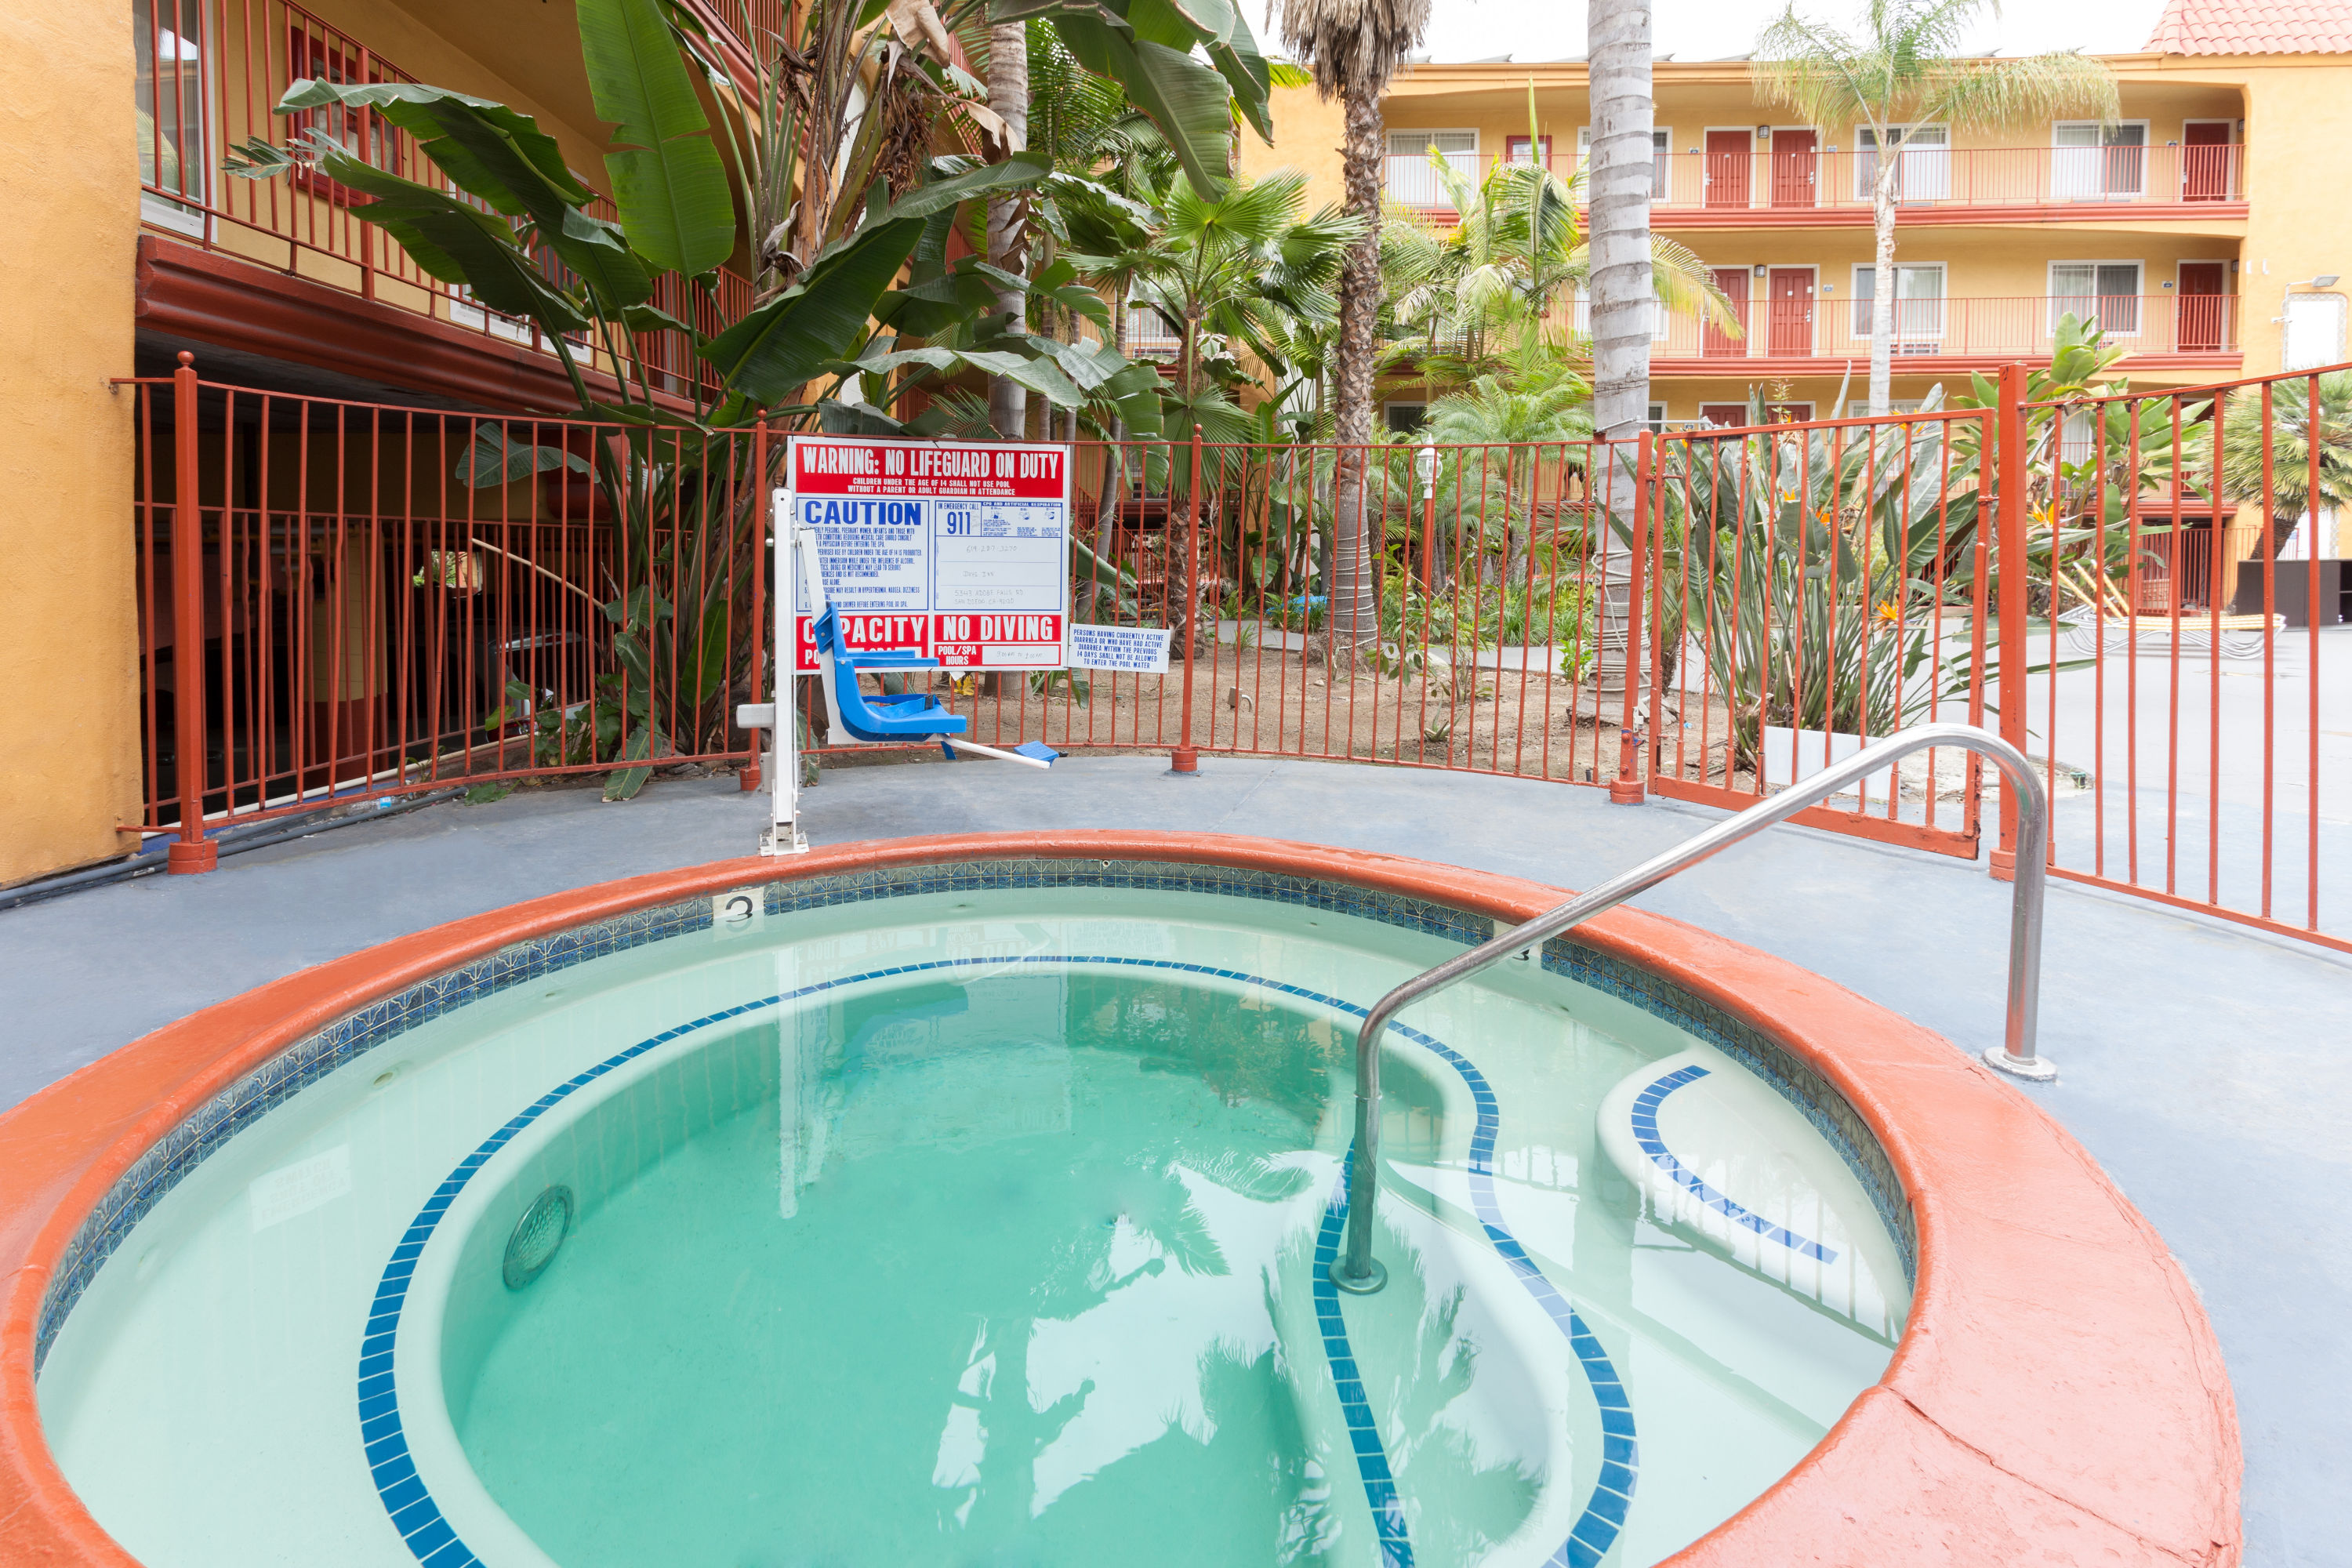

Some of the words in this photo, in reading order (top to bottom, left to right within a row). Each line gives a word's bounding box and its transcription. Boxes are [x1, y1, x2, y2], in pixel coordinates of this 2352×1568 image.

[802, 446, 880, 475] WARNING:
[885, 448, 905, 476] NO
[910, 450, 990, 477] LIFEGUARD
[996, 452, 1014, 478] ON
[1020, 452, 1058, 479] DUTY
[805, 500, 921, 525] CAUTION
[946, 511, 971, 535] 911
[803, 616, 925, 644] CPACITY
[943, 615, 971, 641] NO
[980, 615, 1053, 641] DIVING
[1097, 630, 1115, 638] HAVING
[1116, 631, 1145, 640] CURRENTLY
[938, 645, 977, 655] POOL/SPA
[946, 655, 969, 666] HOURS
[1104, 644, 1121, 653] WITHIN
[1133, 647, 1158, 655] PREVIOUS
